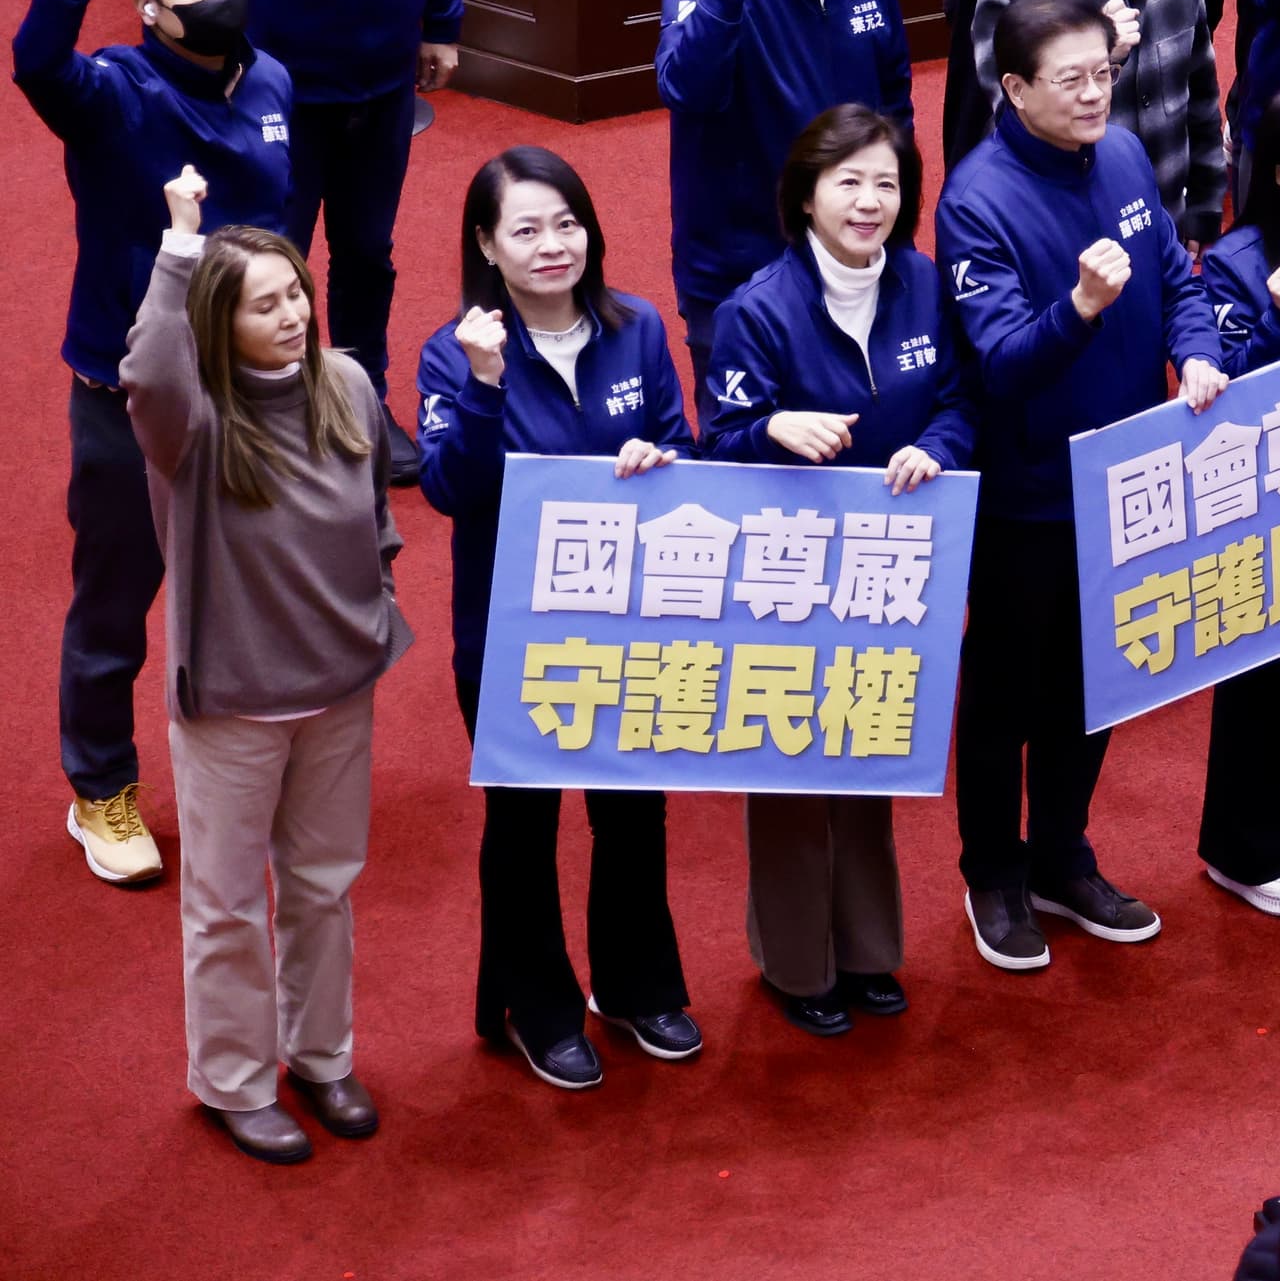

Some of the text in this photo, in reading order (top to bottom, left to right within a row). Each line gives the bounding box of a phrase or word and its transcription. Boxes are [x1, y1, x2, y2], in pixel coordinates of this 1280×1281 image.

[850, 11, 886, 35] 葉元之
[1118, 209, 1152, 239] 羅明才
[532, 501, 933, 626] 國會尊嚴
[520, 637, 921, 757] 守護民權
